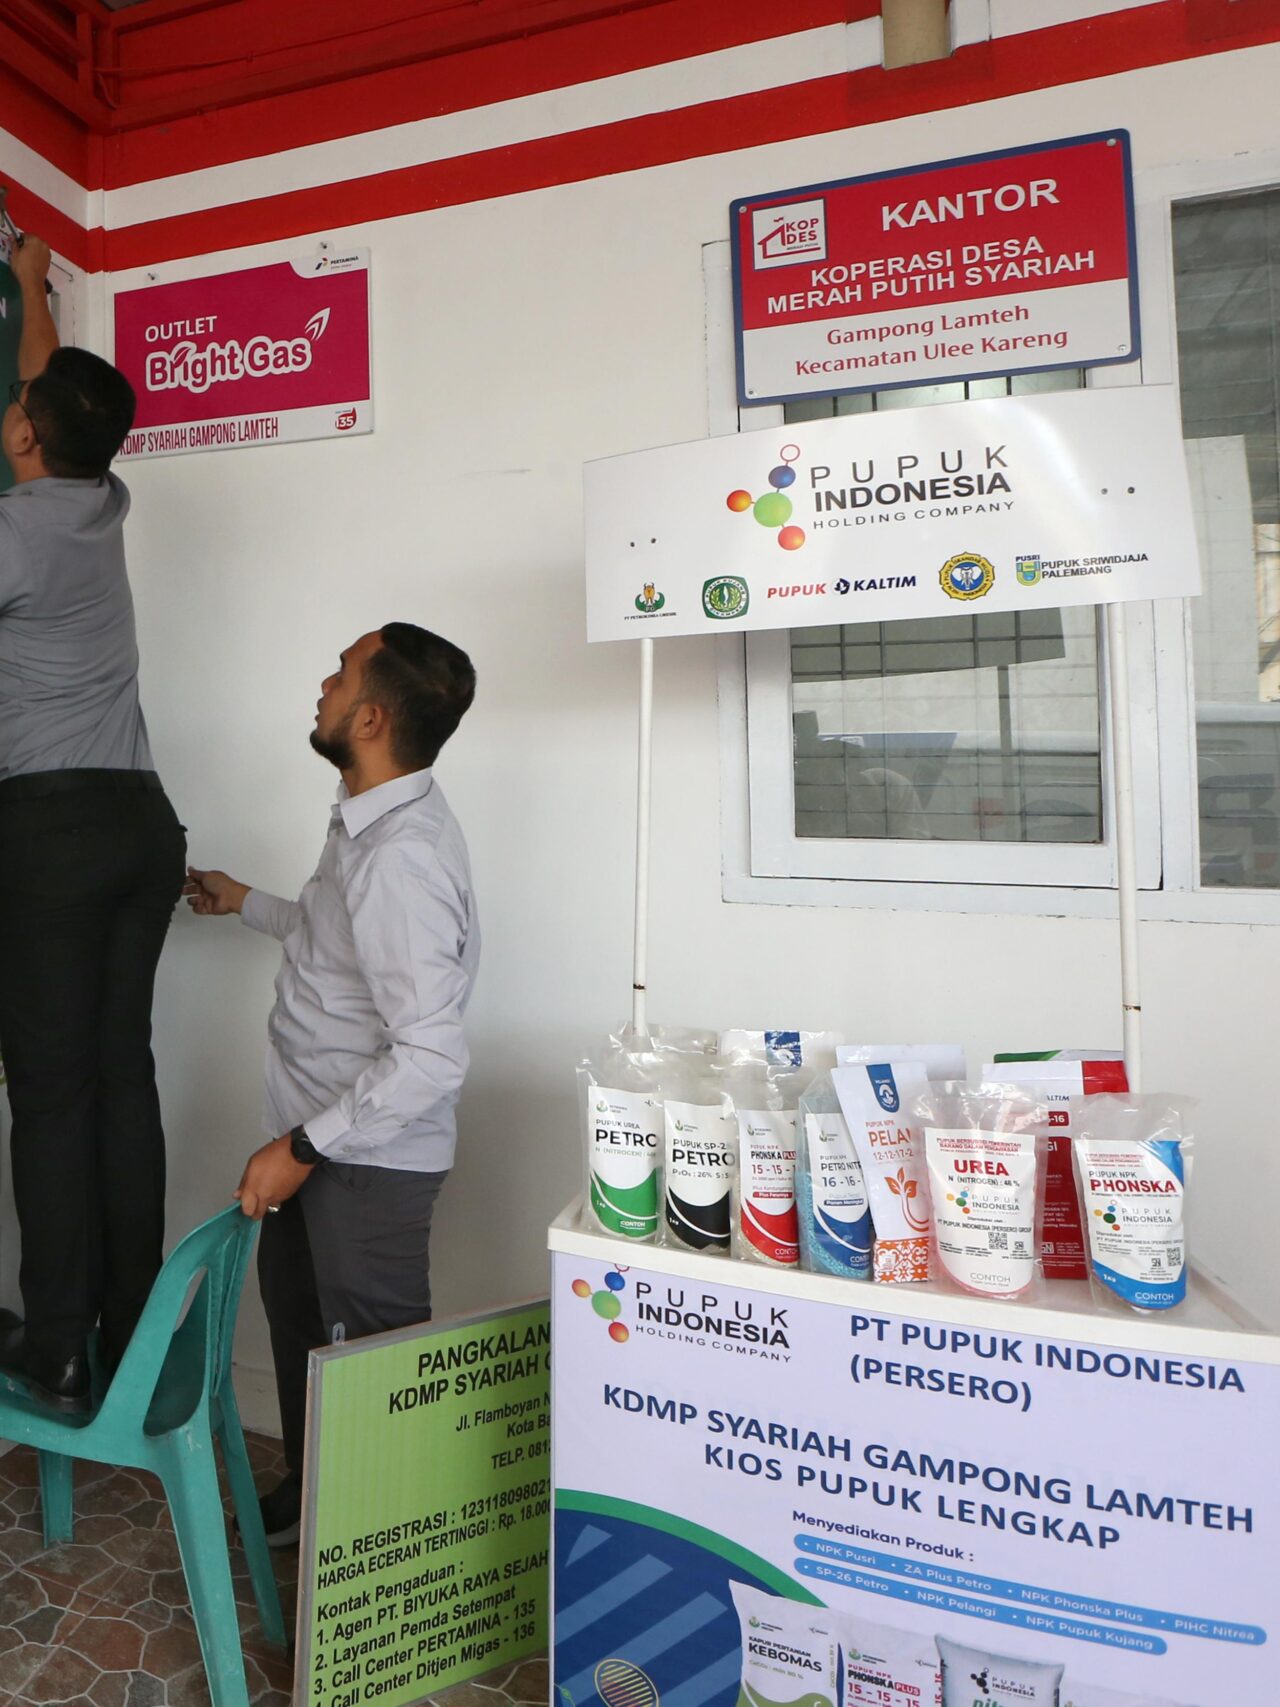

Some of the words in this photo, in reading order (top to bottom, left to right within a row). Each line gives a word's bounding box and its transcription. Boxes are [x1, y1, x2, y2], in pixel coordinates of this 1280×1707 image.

[785, 217, 819, 232] KOP
[882, 178, 1060, 231] KANTOR
[786, 230, 817, 244] DES
[768, 283, 861, 314] MERAH
[872, 270, 955, 300] PUTIH
[965, 250, 1095, 286] SYARIAH
[811, 248, 952, 287] KOPERASI
[962, 235, 1044, 264] DESA
[145, 315, 217, 342] OUTLET
[827, 317, 934, 346] Gampong
[941, 305, 1029, 331] Lamteh
[148, 343, 244, 390] Bright
[246, 337, 311, 377] Gas
[796, 349, 917, 376] Kecamatan
[924, 340, 974, 360] Ulee
[981, 330, 1068, 355] Kareng
[148, 428, 187, 452] SYARIAH
[190, 423, 236, 448] GAMPONG
[238, 417, 278, 441] LAMTEH
[336, 414, 354, 427] 135
[811, 445, 1008, 488] PUPUK
[815, 472, 1011, 512] INDONESIA
[813, 512, 906, 530] HOLDING
[914, 501, 1015, 520] COMPANY
[1042, 559, 1080, 570] PUPUK
[1083, 553, 1148, 567] SRIWIDJAJA
[1042, 565, 1112, 578] PALEMBANG
[767, 582, 826, 599] PUPUK
[853, 576, 916, 592] KALTIM
[596, 1129, 657, 1147] PETRO
[672, 1149, 735, 1166] PETRO
[954, 1159, 1009, 1176] UREA
[1090, 1179, 1176, 1193] PHONSKA
[972, 1202, 1020, 1211] INDONESIA
[636, 1281, 788, 1328] PUPUK
[1135, 1291, 1174, 1300] CONTOH
[636, 1325, 706, 1346] HOLDING
[712, 1339, 791, 1363] COMPANY
[638, 1302, 790, 1349] INDONESIA
[418, 1321, 550, 1378] PANGKALAN
[850, 1315, 890, 1341] PT
[902, 1323, 1023, 1363] PUPUK
[1035, 1343, 1246, 1393] INDONESIA
[389, 1378, 448, 1414] KDMP
[454, 1354, 538, 1396] SYARIAH
[850, 1354, 1032, 1412] (PERSERO)
[456, 1415, 470, 1432] Jl.
[475, 1396, 540, 1427] Flamboyan
[507, 1418, 534, 1438] Kota
[491, 1449, 525, 1470] TELP.
[604, 1384, 697, 1425] KDMP
[707, 1409, 851, 1462] SYARIAH
[863, 1444, 1072, 1505] GAMPONG
[1086, 1484, 1254, 1533] LAMTEH
[705, 1444, 783, 1481] KIOS
[797, 1465, 923, 1512] PUPUK
[938, 1495, 1120, 1550] LENGKAP
[318, 1561, 365, 1590] HARGA
[369, 1543, 421, 1573] ECERAN
[425, 1517, 489, 1554] TERTINGGI
[498, 1513, 516, 1530] Rp.
[319, 1545, 346, 1567] NO.
[352, 1510, 447, 1557] REGISTRASI
[793, 1510, 901, 1546] Menyediakan
[905, 1536, 964, 1560] Produk
[317, 1591, 371, 1622] Kontak
[375, 1564, 455, 1602] Pengaduan
[333, 1613, 372, 1641] Agen
[377, 1606, 398, 1626] PT.
[403, 1583, 459, 1616] BIYUKA
[463, 1567, 500, 1594] RAYA
[816, 1543, 842, 1556] NPK
[845, 1550, 876, 1565] Pusri
[904, 1564, 923, 1576] ZA
[927, 1569, 953, 1582] Plus
[956, 1576, 992, 1591] Petro
[1021, 1589, 1049, 1603] NPK
[1054, 1596, 1111, 1616] Phonska
[1115, 1609, 1143, 1622] Plus
[1175, 1619, 1208, 1633] PIHC
[1212, 1625, 1255, 1641] Nitrea
[816, 1566, 852, 1582] SP-26
[855, 1576, 889, 1592] Petro
[917, 1591, 945, 1604] NPK
[948, 1597, 997, 1617] Pelangi
[1026, 1615, 1054, 1629] NPK
[1059, 1622, 1102, 1640] Pupuk
[1105, 1631, 1153, 1650] Kujang
[332, 1665, 360, 1690] Call
[365, 1648, 413, 1675] Center
[417, 1613, 501, 1657] PERTAMINA
[513, 1599, 536, 1618] 135
[333, 1632, 396, 1665] Layanan
[400, 1611, 448, 1640] Pemda
[453, 1585, 516, 1621] Setempat
[331, 1689, 360, 1707] Call
[364, 1670, 412, 1700] Center
[416, 1652, 456, 1680] Ditjen
[460, 1636, 500, 1663] Migas
[513, 1621, 535, 1641] 136
[748, 1643, 823, 1672] KEBOMAS
